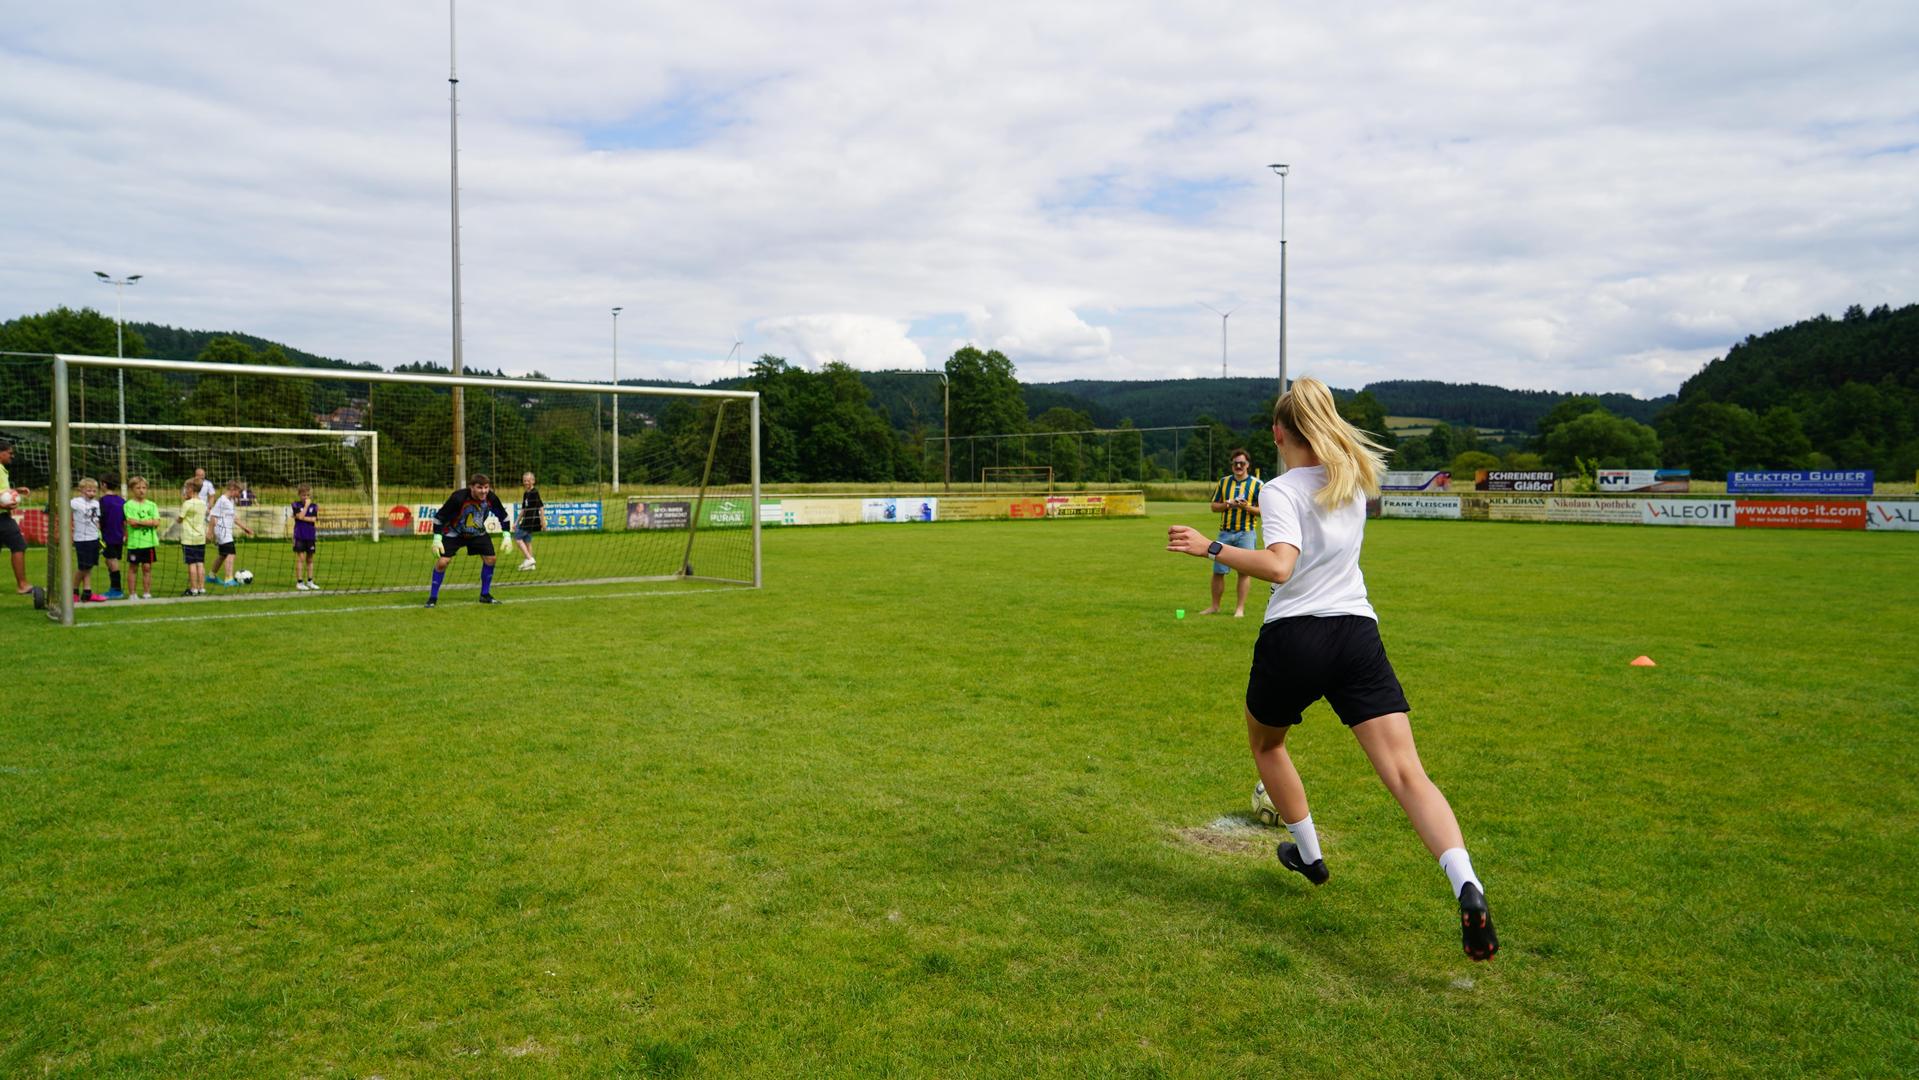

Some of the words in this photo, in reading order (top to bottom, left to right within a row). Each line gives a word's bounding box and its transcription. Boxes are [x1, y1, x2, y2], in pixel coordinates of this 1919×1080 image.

[1488, 471, 1554, 481] SCHREINEREI
[1513, 480, 1553, 491] Gläßer
[1384, 500, 1413, 508] FRANK
[1416, 500, 1458, 508] FLEISCHER
[1553, 499, 1591, 508] Nikolaus
[1594, 500, 1637, 511] Apotheke
[1713, 503, 1731, 519] IT
[1735, 505, 1862, 517] www.valeo-it.com
